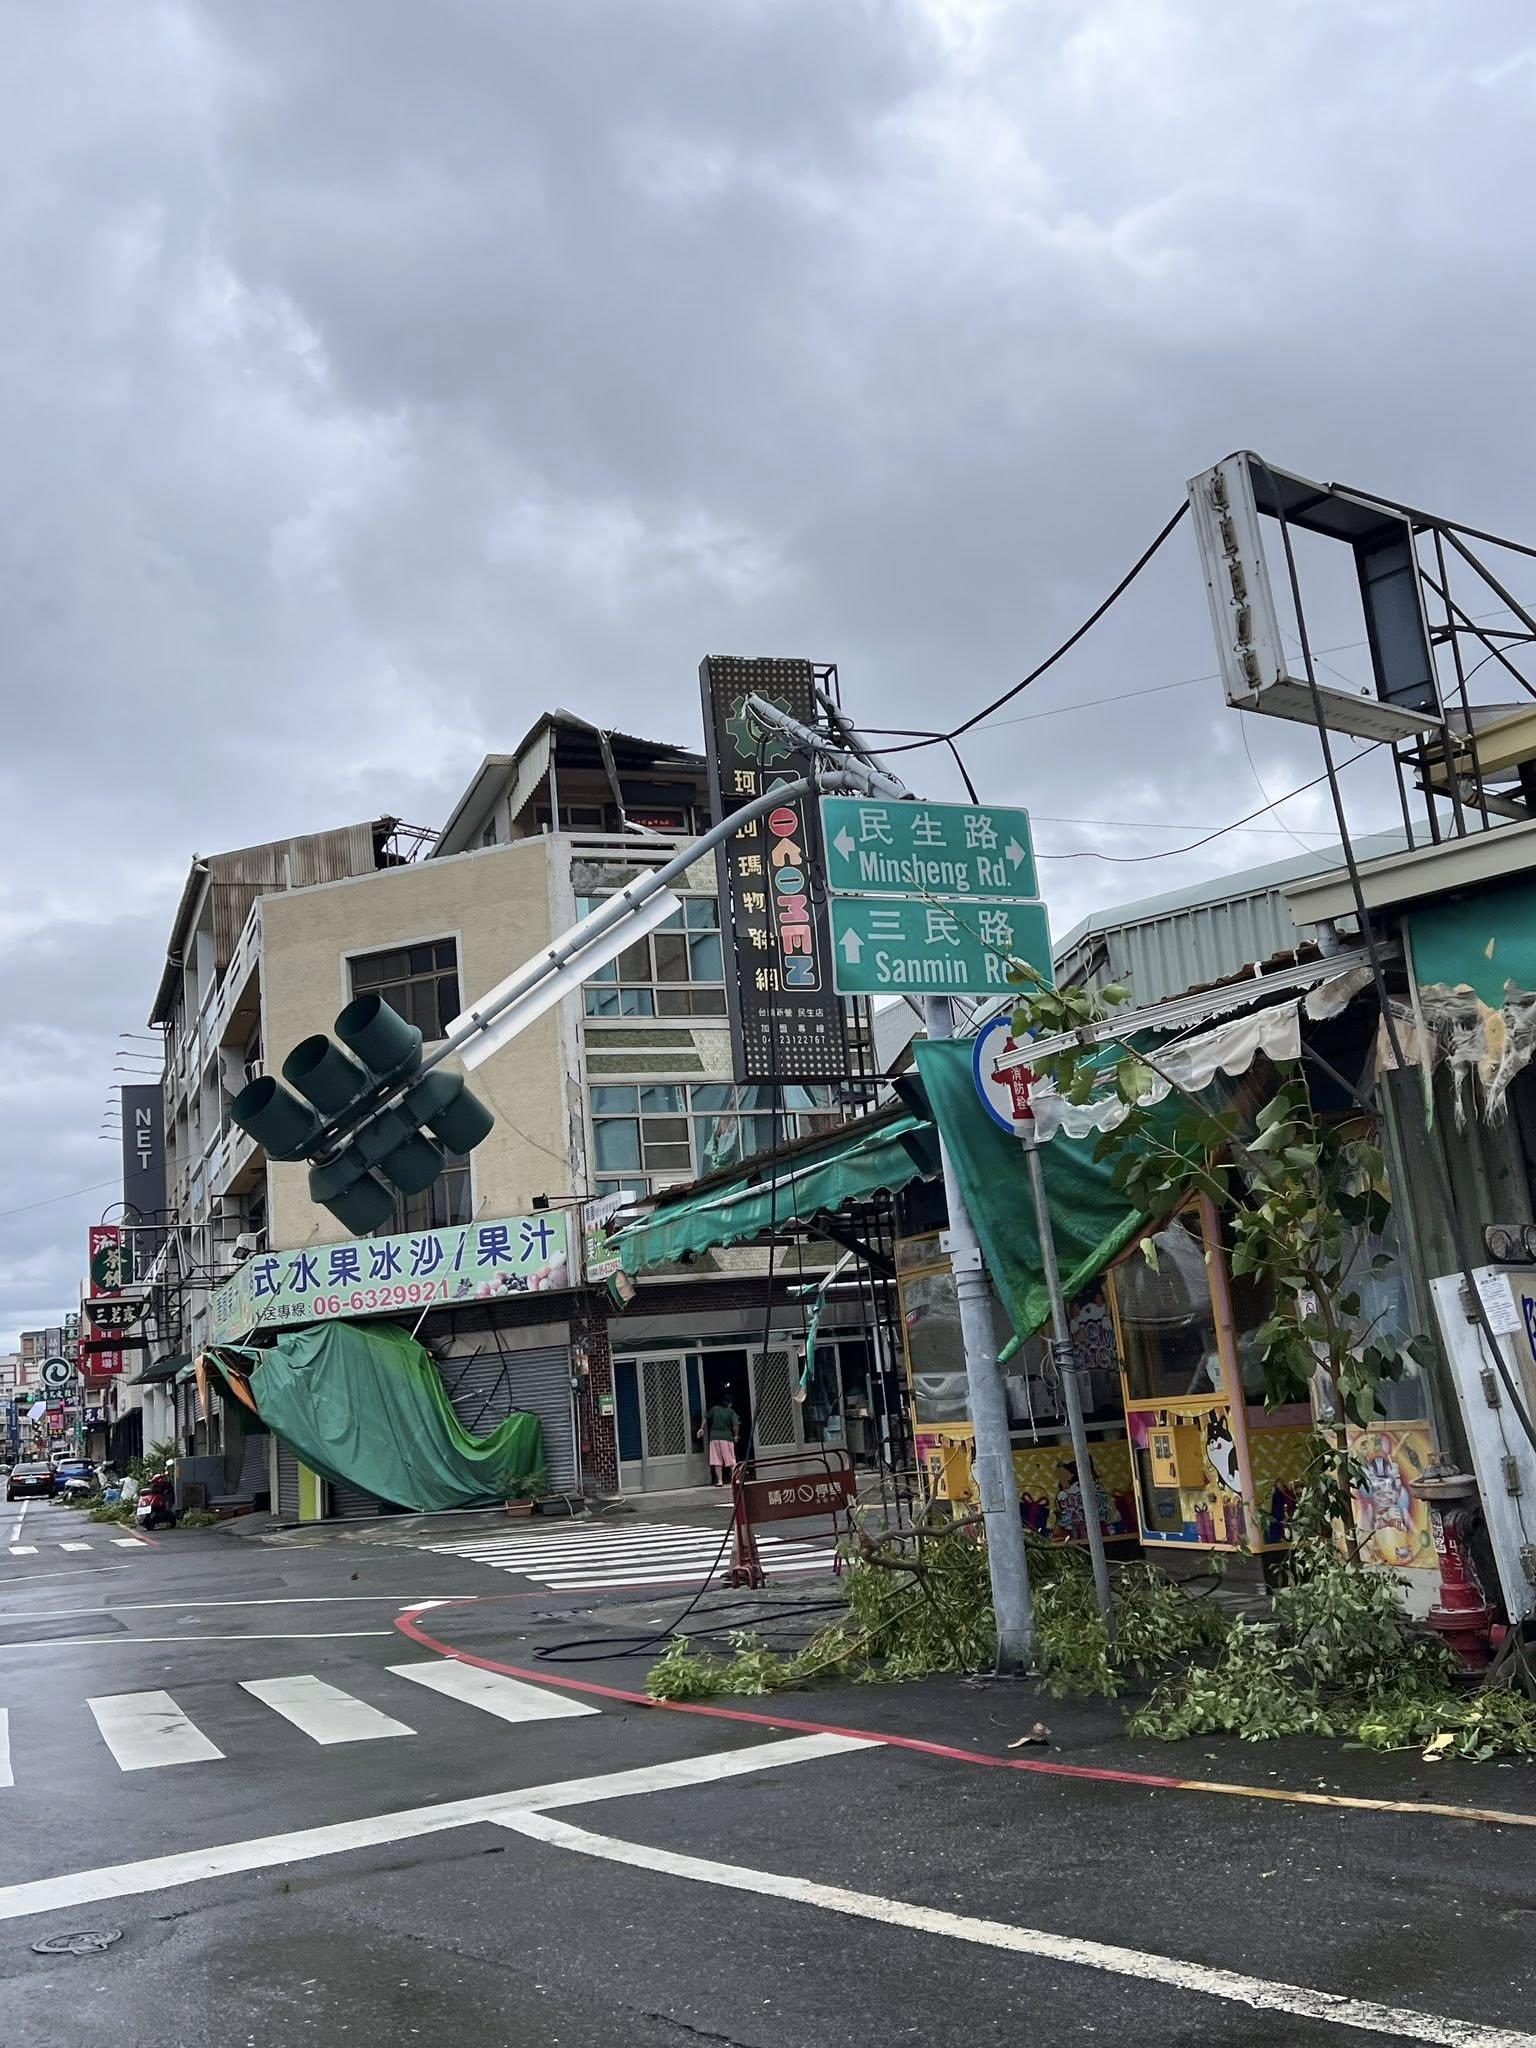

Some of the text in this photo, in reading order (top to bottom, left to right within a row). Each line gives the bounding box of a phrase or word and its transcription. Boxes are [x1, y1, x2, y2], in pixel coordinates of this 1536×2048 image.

[858, 808, 999, 850] 民生路
[859, 850, 1012, 892] Minsheng Rd.
[867, 908, 1014, 946] 三民路
[875, 950, 968, 984] Sanmin
[797, 1007, 824, 1018] 民生店
[135, 1108, 152, 1169] NET
[313, 1279, 449, 1315] 06-6329921
